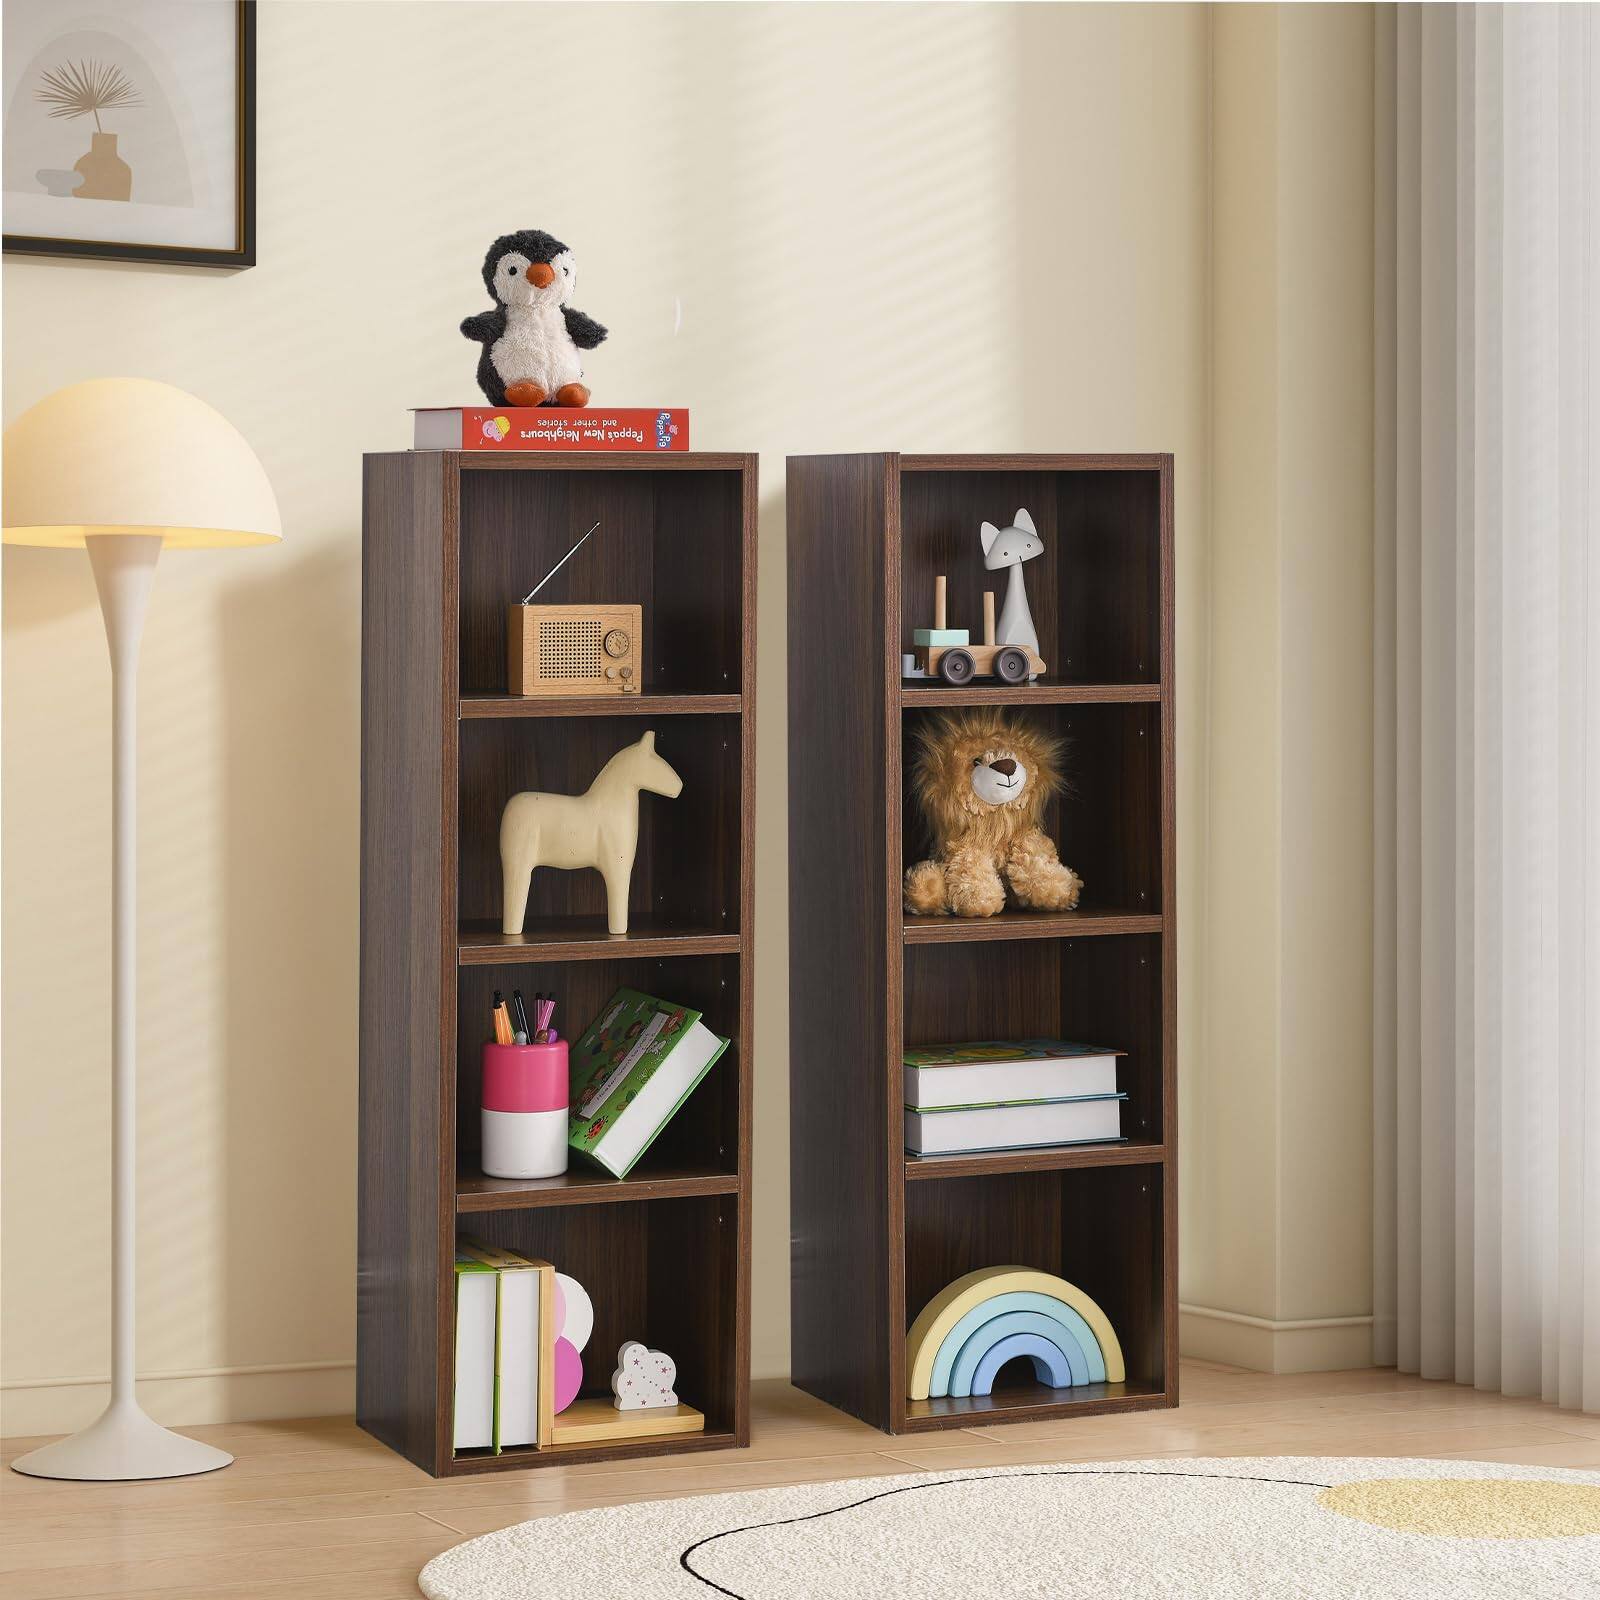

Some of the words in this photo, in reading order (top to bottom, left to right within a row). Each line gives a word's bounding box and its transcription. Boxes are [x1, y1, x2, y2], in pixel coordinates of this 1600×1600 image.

[537, 419, 568, 427] stories
[602, 419, 617, 427] and
[656, 412, 670, 435] Peppa
[520, 427, 580, 442] Neighbours
[584, 430, 605, 441] New
[608, 427, 643, 442] Peppa's
[659, 436, 671, 448] Pig
